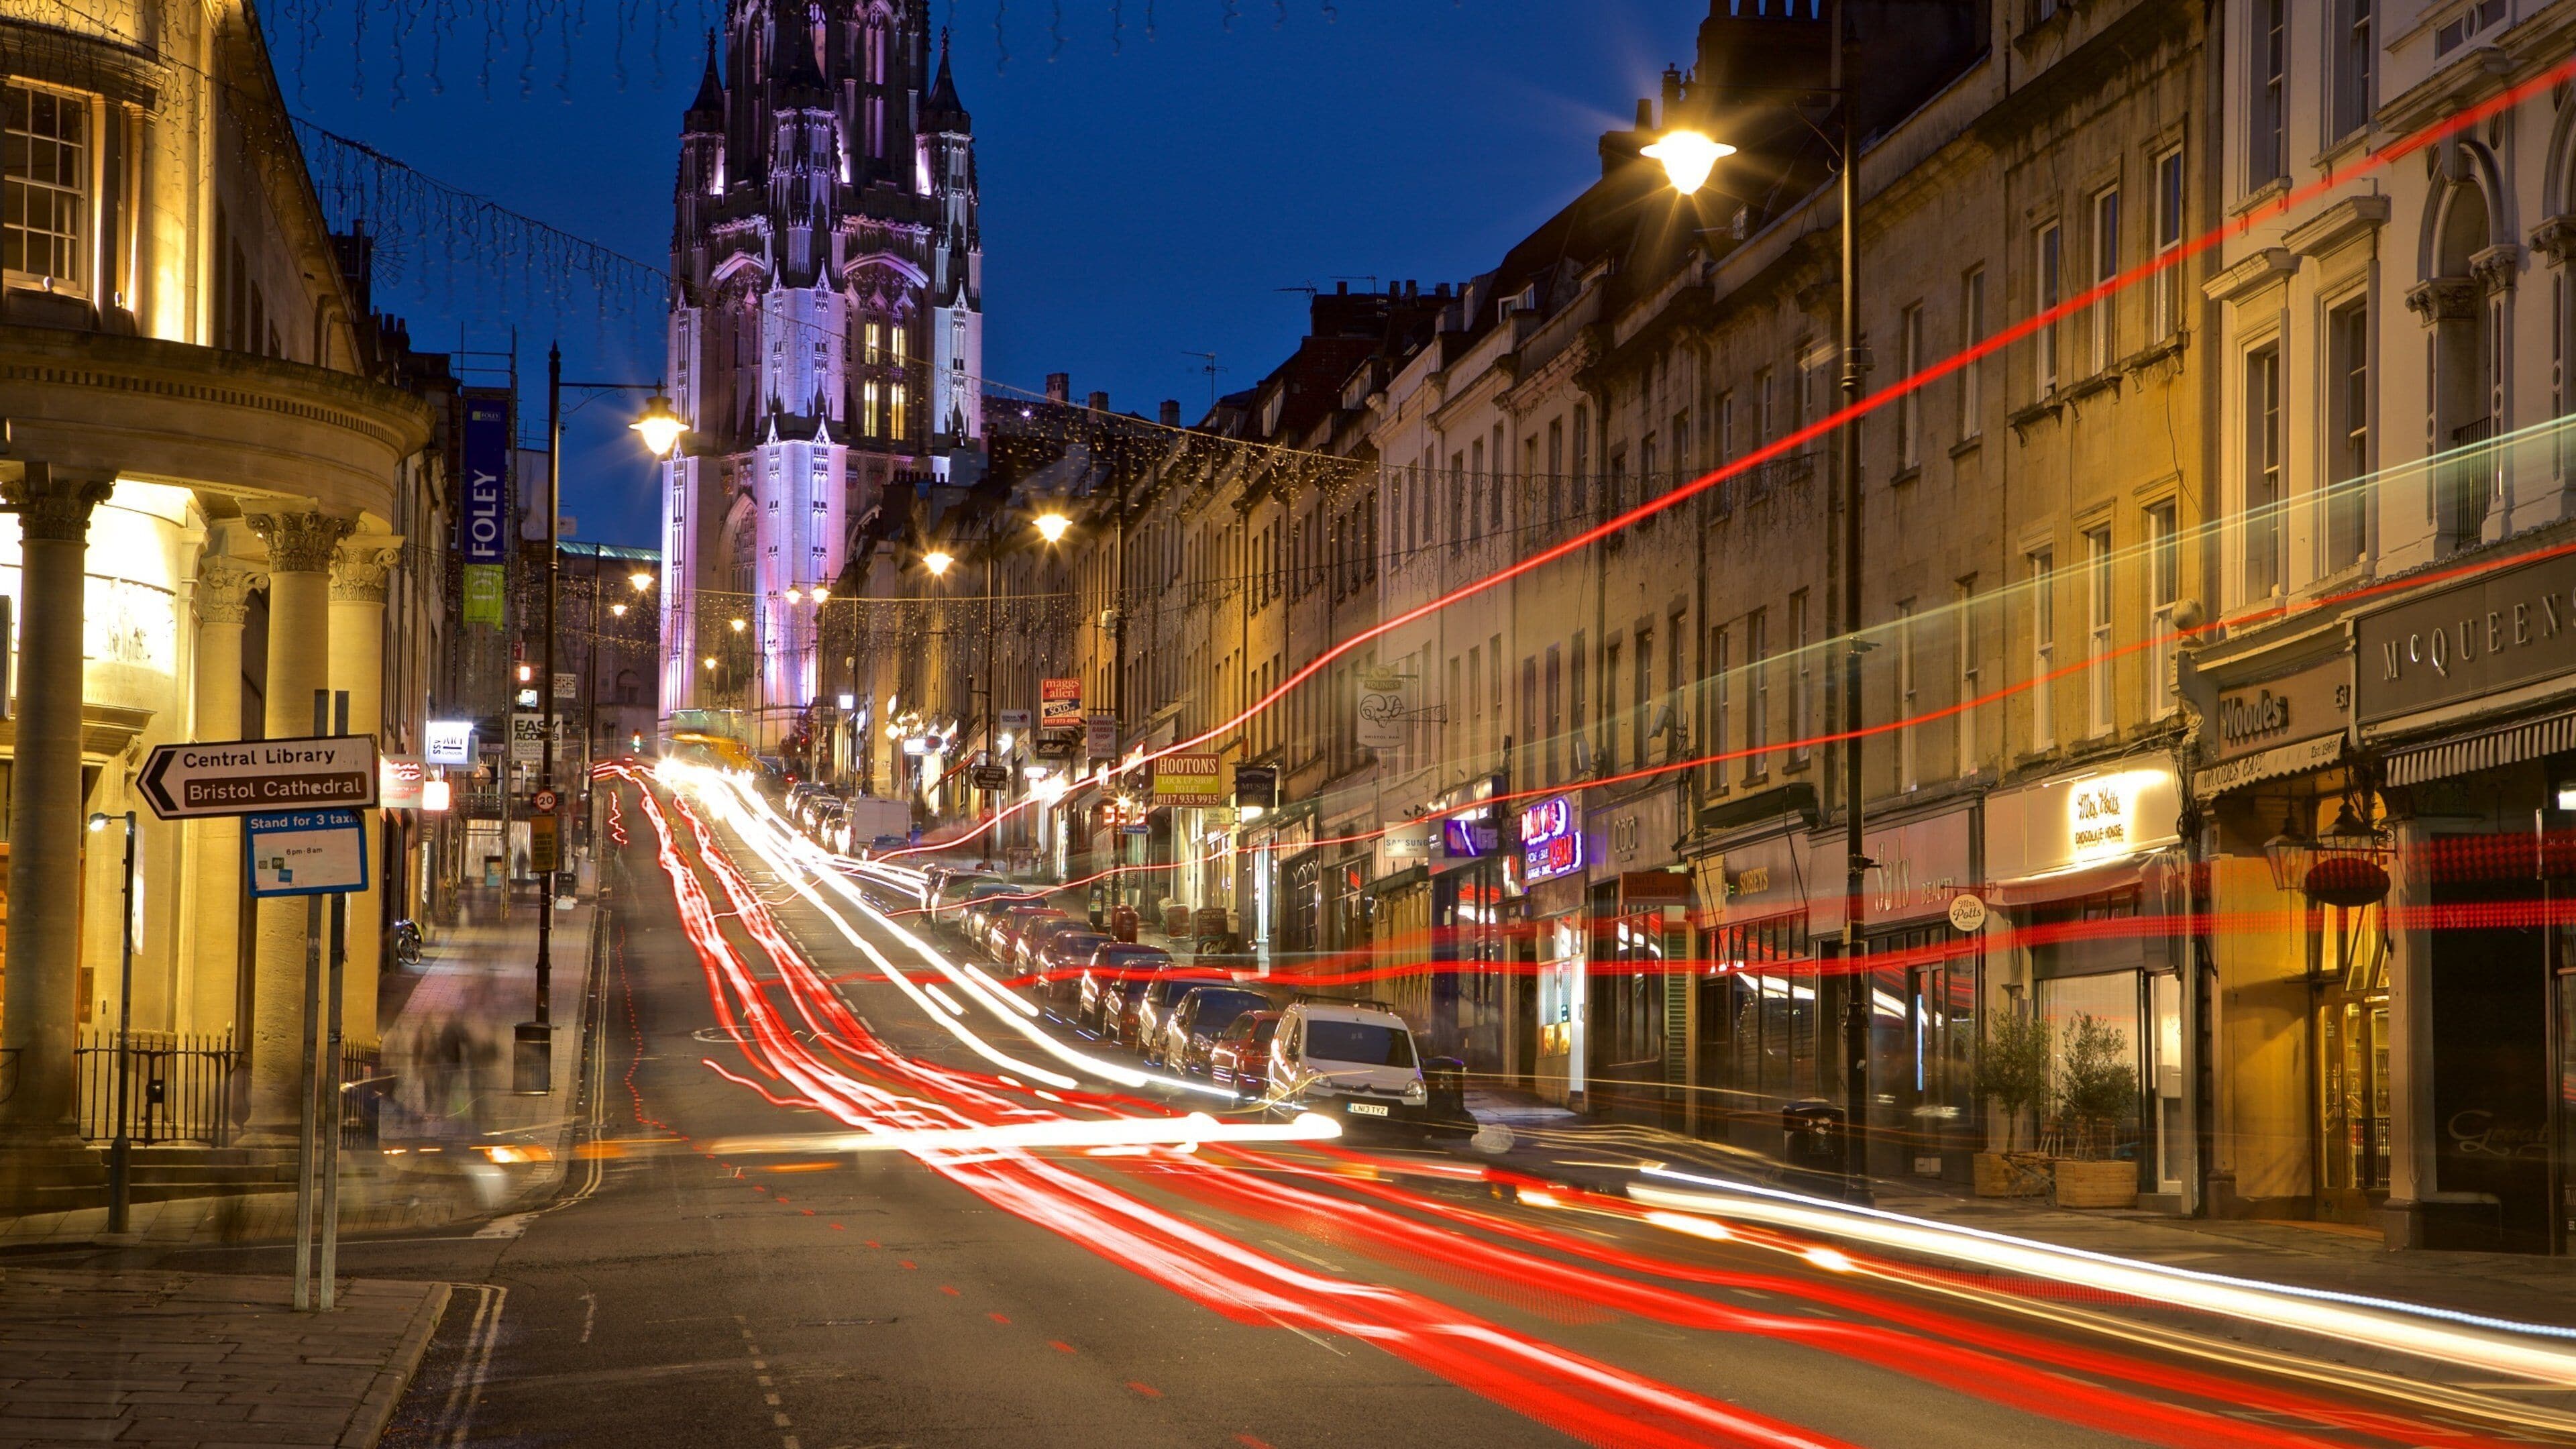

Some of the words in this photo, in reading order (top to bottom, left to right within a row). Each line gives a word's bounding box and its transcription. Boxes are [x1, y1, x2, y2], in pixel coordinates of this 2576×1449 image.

[472, 469, 497, 557] FOLEY
[1046, 679, 1079, 690] maggs
[1050, 688, 1074, 698] allen
[1049, 704, 1069, 715] SOLD
[2222, 693, 2282, 739] Woodes
[515, 720, 560, 732] EASY
[515, 733, 559, 741] ACCS
[184, 750, 257, 768] Central
[266, 748, 335, 765] Library
[1159, 758, 1216, 773] HOOTONS
[190, 783, 256, 800] Bristol
[264, 778, 362, 797] Cathedral
[539, 796, 553, 805] 20
[1157, 794, 1177, 804] 0117
[1179, 794, 1194, 804] 933
[1197, 794, 1218, 804] 9915
[251, 817, 288, 829] Stand
[293, 815, 311, 826] for
[317, 814, 325, 825] 3
[1627, 875, 1658, 885] UNITE
[1739, 867, 1768, 896] SOBEYS
[1921, 876, 1956, 905] BEAUTY
[1953, 907, 1981, 921] Potts
[1372, 1107, 1385, 1115] TYZ
